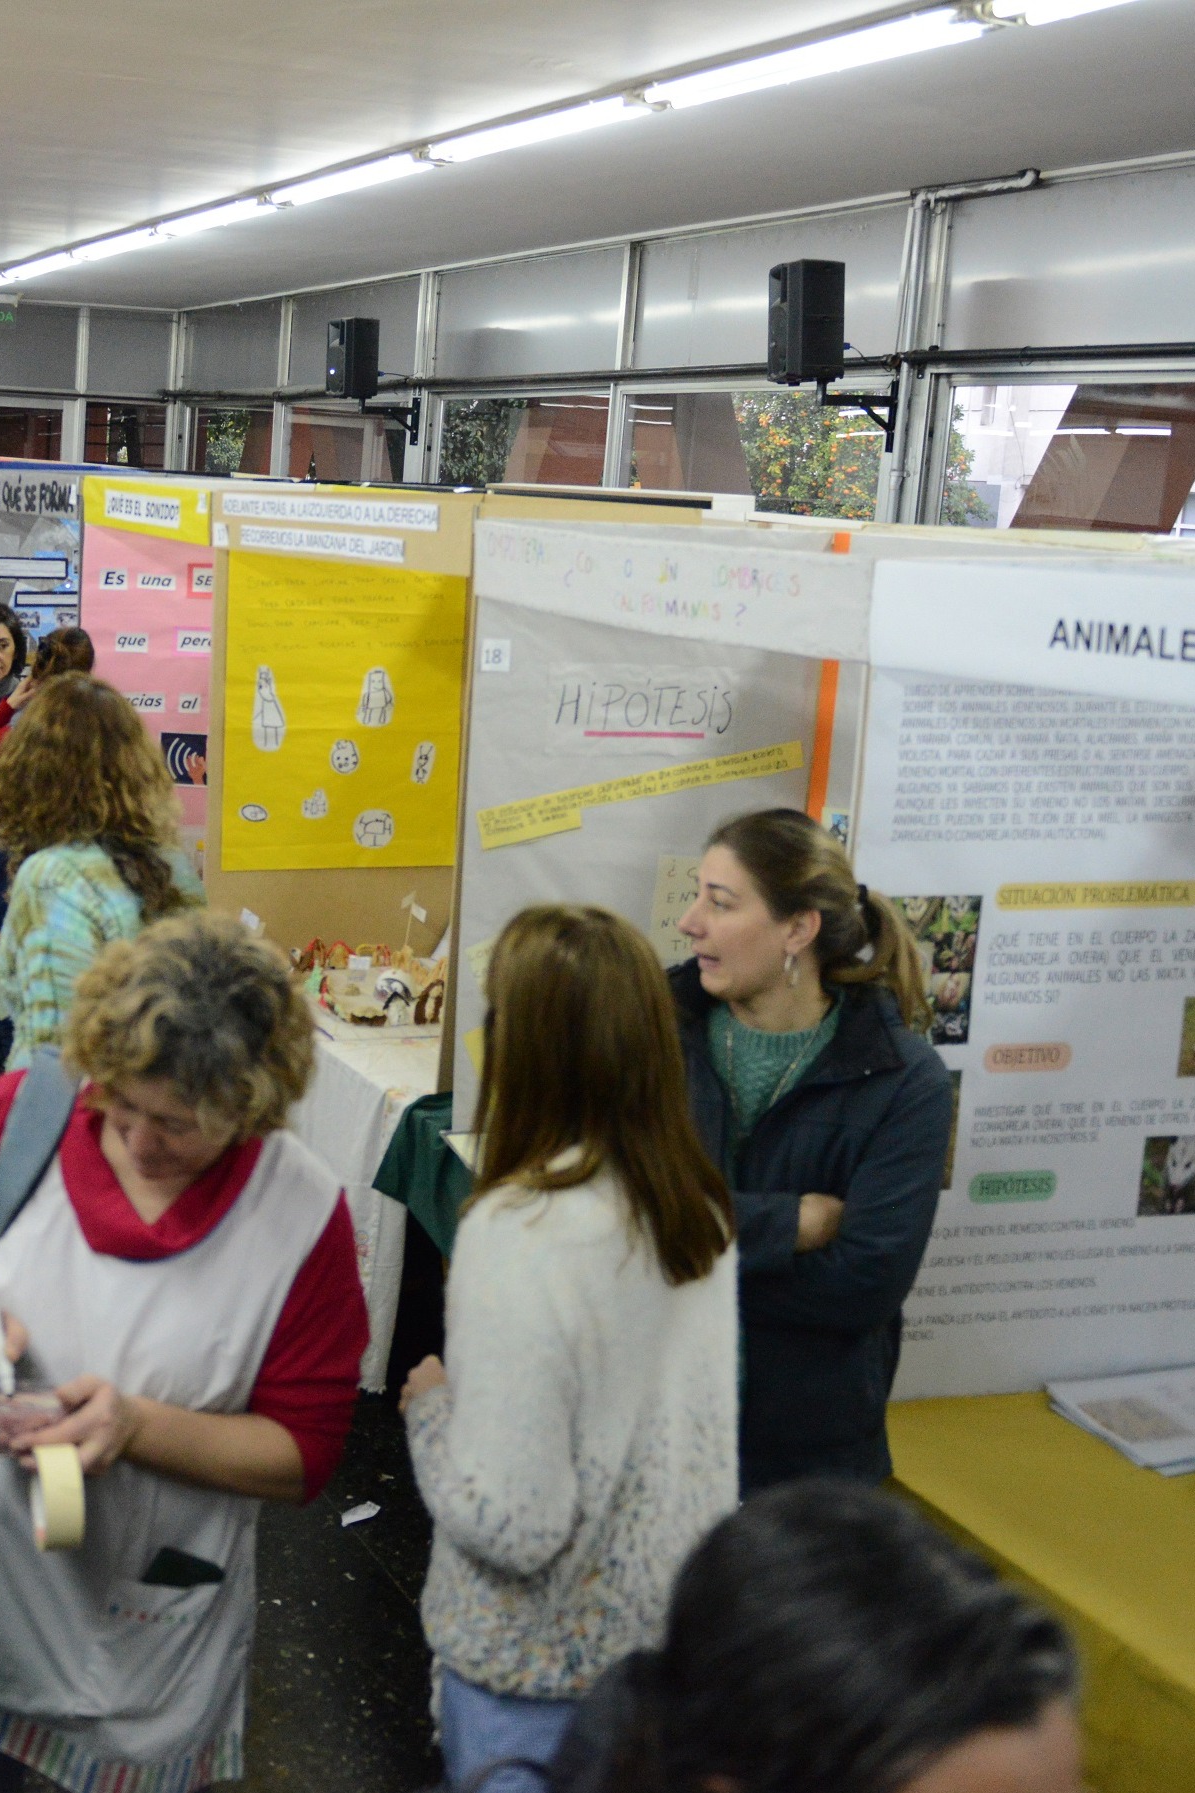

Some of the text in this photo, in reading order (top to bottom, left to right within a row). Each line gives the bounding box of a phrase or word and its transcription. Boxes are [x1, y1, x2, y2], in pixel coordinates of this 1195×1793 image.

[2, 474, 21, 512] QUÉ
[25, 484, 36, 512] SE
[107, 494, 179, 521] ¿QUÉ ES EL SONIDO?
[297, 502, 307, 517] LA
[307, 502, 353, 520] IZQUIERDA
[354, 505, 362, 521] O
[363, 507, 371, 521] A
[372, 507, 385, 523] LA
[386, 506, 437, 526] DERECHA
[241, 528, 293, 546] RECORREMOS
[294, 532, 304, 547] LA
[306, 533, 347, 552] MANZANA
[349, 537, 366, 554] DEL
[104, 571, 125, 585] Es
[140, 574, 172, 587] una
[117, 635, 147, 647] que
[484, 648, 503, 665] 18
[181, 697, 198, 710] al
[998, 885, 1190, 905] SITUACIÓN PROBLEMÁTICA
[1028, 932, 1060, 946] TIENE
[1067, 931, 1083, 945] EN
[1090, 931, 1103, 945] EL
[1110, 930, 1157, 944] CUERPO
[1163, 930, 1177, 943] LA
[1117, 949, 1142, 965] QUE
[1149, 949, 1163, 962] EL
[985, 971, 1040, 986] ALGUNOS
[1045, 970, 1102, 985] ANIMALES
[1107, 969, 1125, 983] NO
[992, 1047, 1061, 1065] OBJETIVO
[978, 1178, 1052, 1197] HIPÓTESIS
